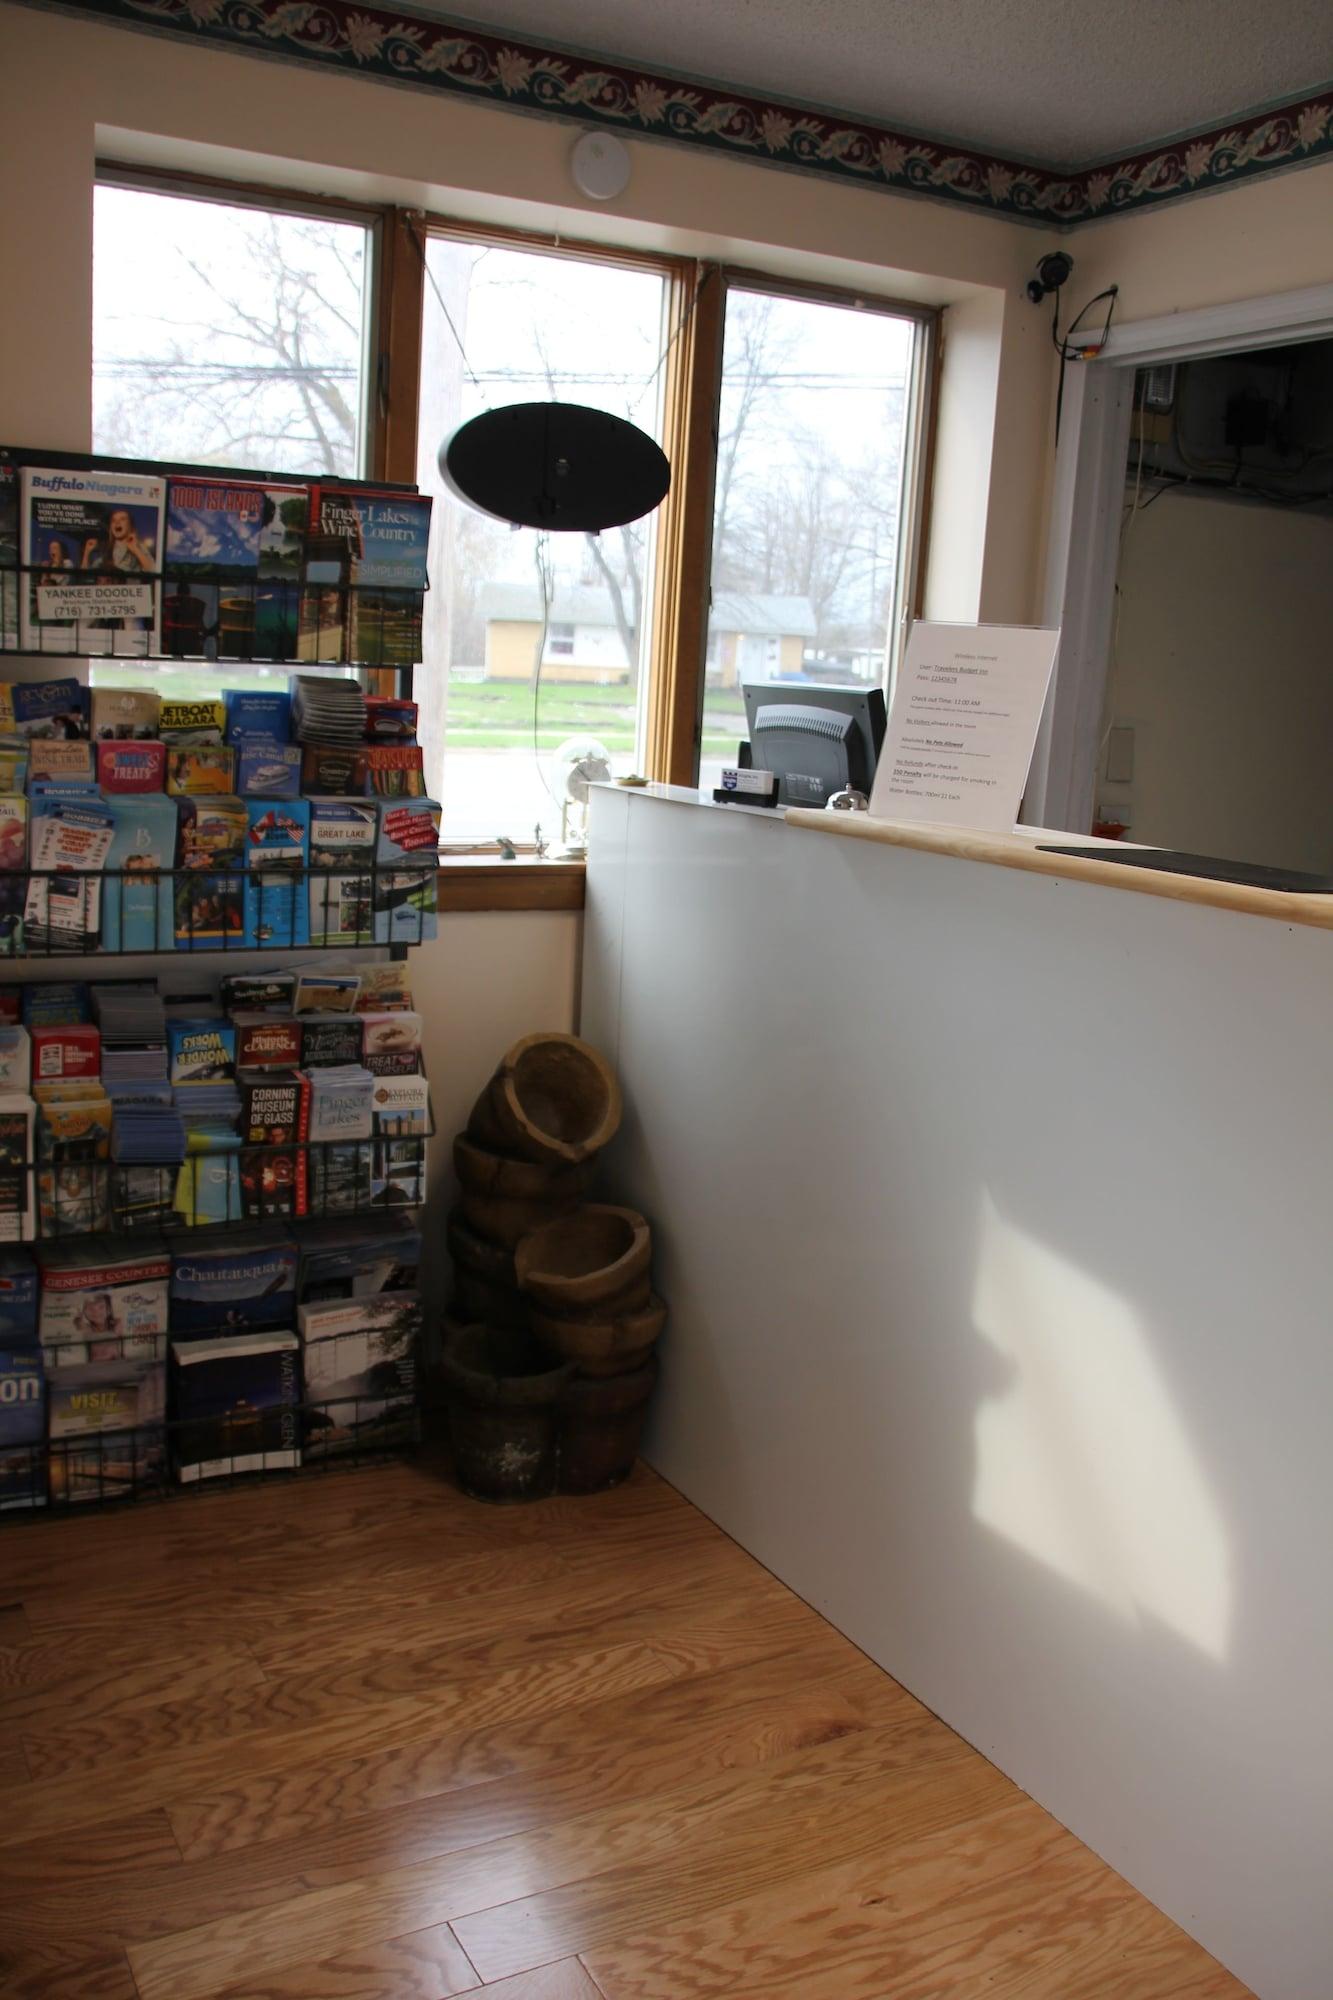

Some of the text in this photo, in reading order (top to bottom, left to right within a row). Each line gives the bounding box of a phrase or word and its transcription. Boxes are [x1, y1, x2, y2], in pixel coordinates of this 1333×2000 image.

[173, 487, 259, 512] 1000 ISLANDS
[321, 502, 409, 523] Finger Lakes
[321, 519, 417, 546] Wine Country
[361, 565, 422, 578] SIMPLIFIED
[45, 587, 143, 599] YANKEE DOODLE
[55, 605, 136, 617] (716) 731-5795
[161, 703, 217, 718] JETBOAT
[160, 715, 217, 727] NIAGARA
[113, 767, 151, 780] TREATS
[318, 830, 366, 839] GREAT LAKE
[183, 1032, 221, 1048] WORKS
[244, 1040, 296, 1053] CLARENCE
[177, 1049, 230, 1065] WONDER
[367, 1056, 399, 1066] TREAT
[252, 1088, 295, 1101] CORNING
[251, 1101, 295, 1113] MUSEUM
[320, 1094, 367, 1113] Finger
[251, 1113, 294, 1125] OF GLASS
[318, 1111, 360, 1126] Lakes
[46, 1264, 168, 1288] GENESEE COUNTRY
[176, 1262, 279, 1283] Chautauqua
[281, 1352, 294, 1409] WATKIN
[0, 1377, 40, 1402] on
[70, 1392, 118, 1409] VISIT
